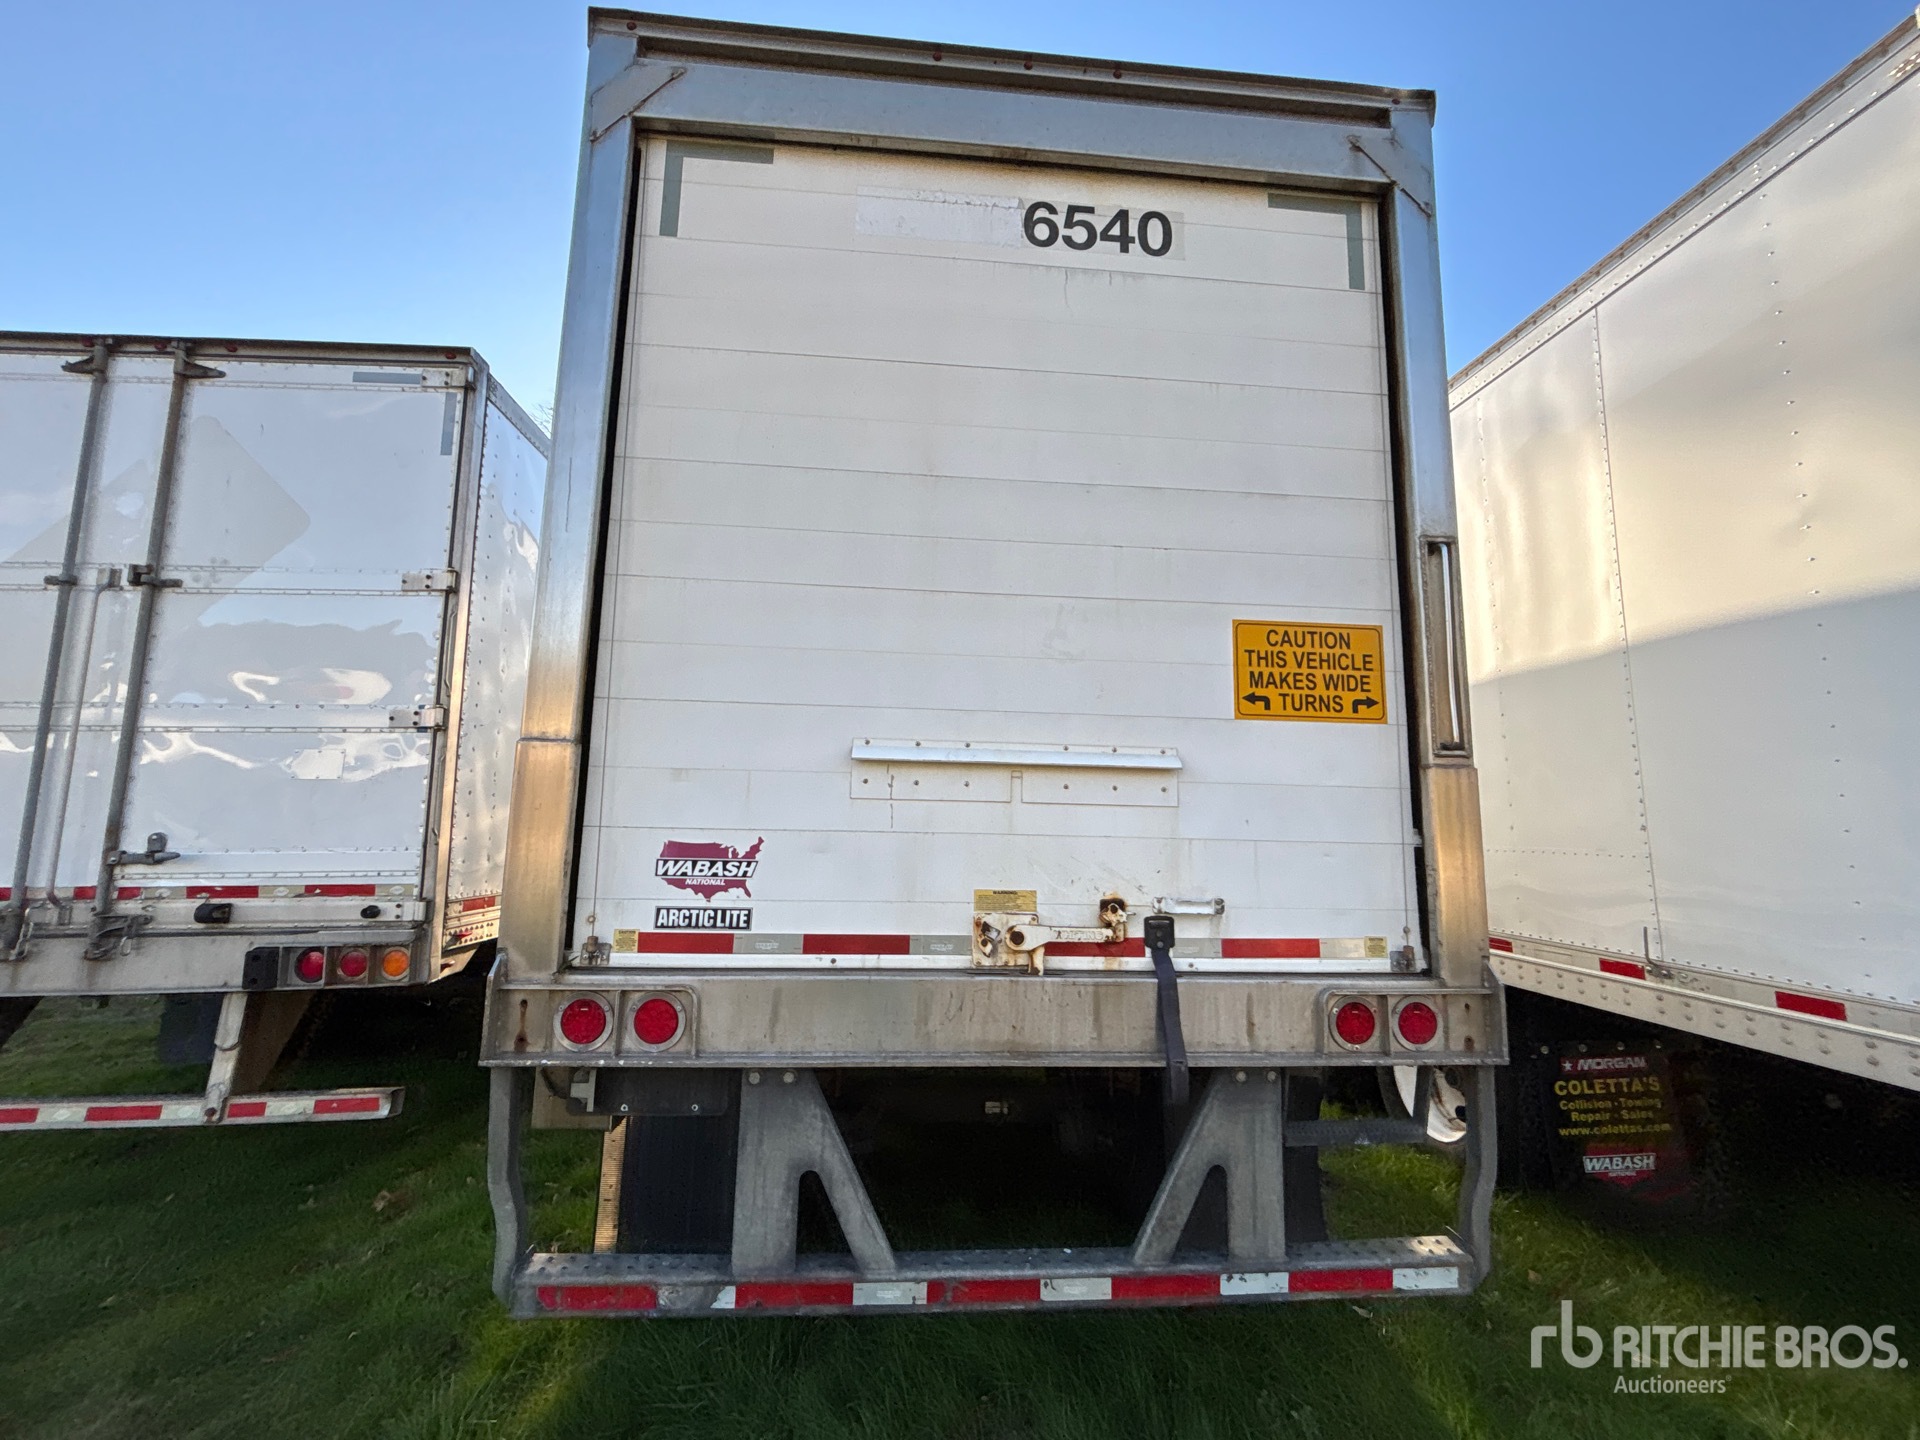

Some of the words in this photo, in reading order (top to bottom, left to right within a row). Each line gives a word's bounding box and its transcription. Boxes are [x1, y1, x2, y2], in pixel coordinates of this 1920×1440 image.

[1024, 201, 1172, 257] 6540
[1266, 629, 1351, 650] CAUTION
[1244, 649, 1287, 668] THIS
[1293, 651, 1374, 671] VEHICLE
[1249, 671, 1317, 690] MAKES
[1322, 673, 1371, 692] WIDE
[1278, 693, 1344, 713] TURNS
[656, 860, 757, 877] WABASH
[685, 878, 726, 886] NATIONAL
[657, 909, 715, 927] ARCTIC
[716, 910, 749, 928] LITE
[1577, 1056, 1647, 1071] MORGAN
[1554, 1077, 1660, 1095] COLETTA'S
[1560, 1099, 1612, 1111] Collision
[1619, 1097, 1662, 1109] Towing
[1571, 1111, 1611, 1123] Repair
[1621, 1109, 1655, 1120] Sales
[1558, 1123, 1672, 1136] www.colettas.com
[1585, 1155, 1655, 1171] WABASH
